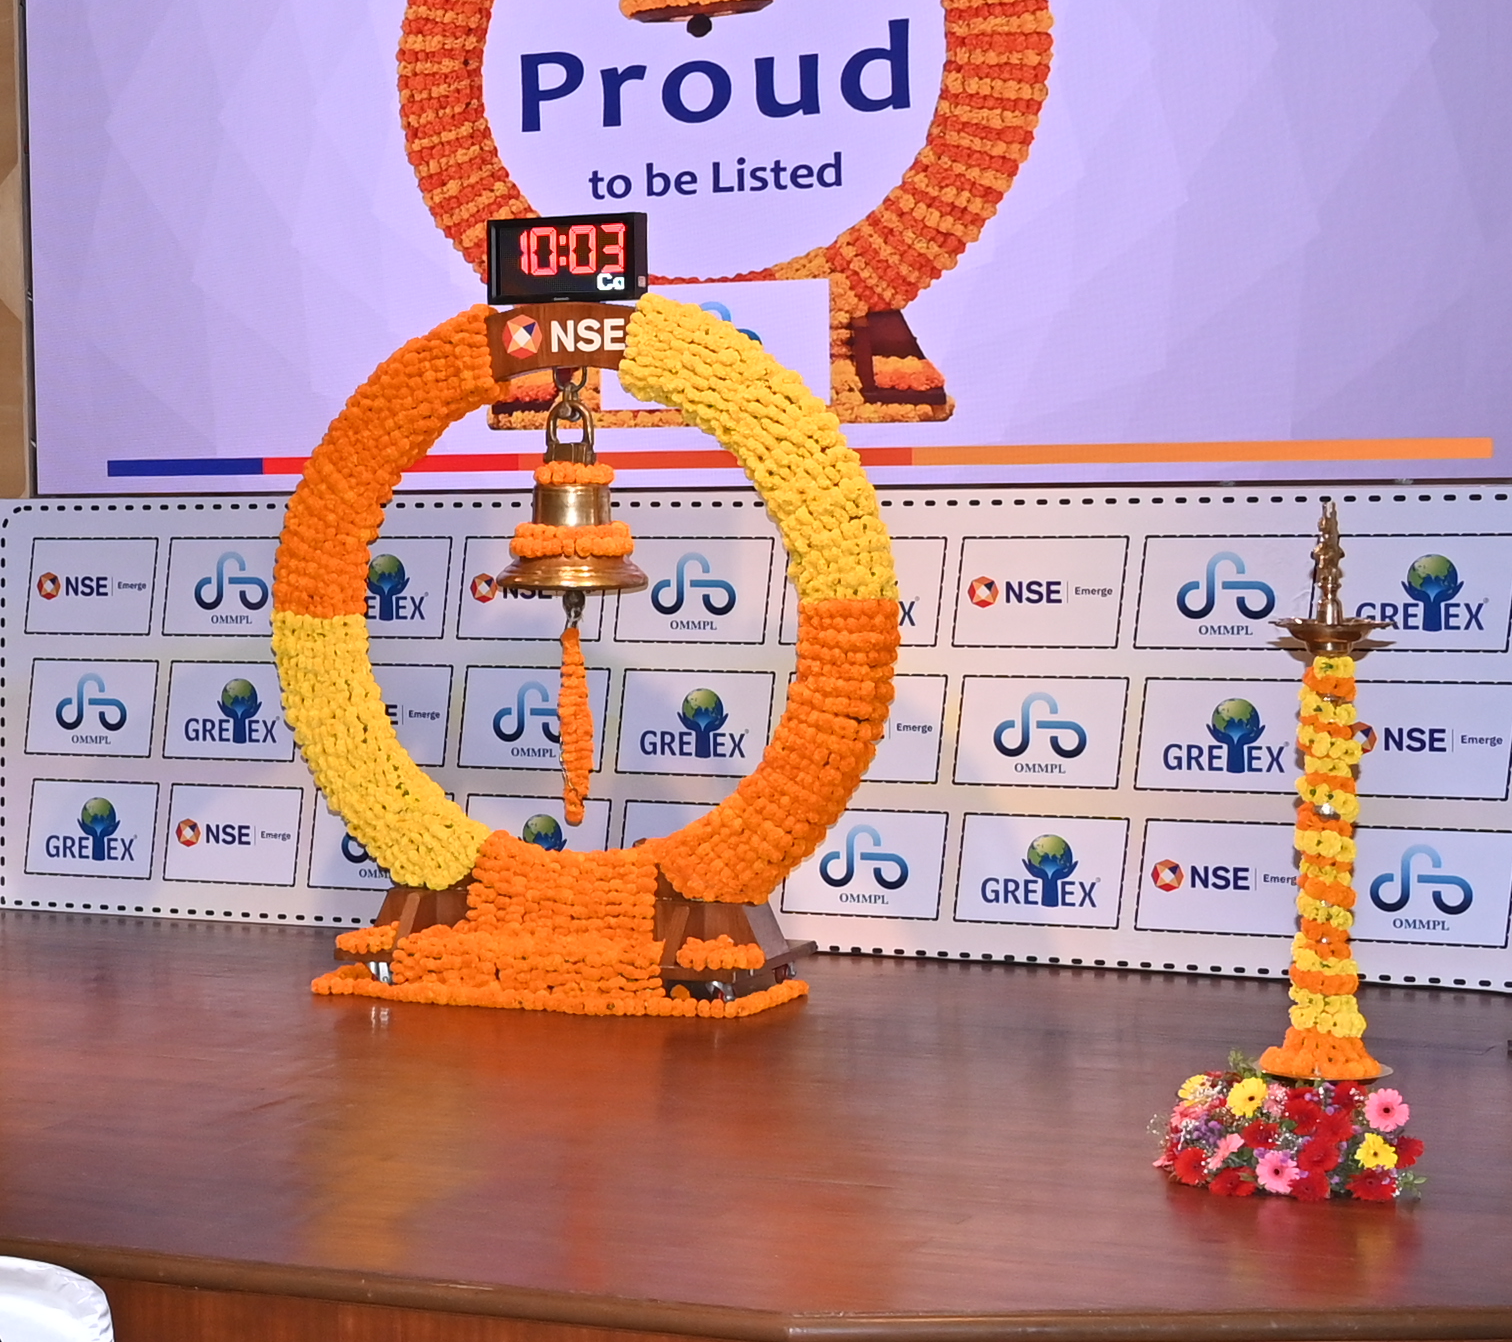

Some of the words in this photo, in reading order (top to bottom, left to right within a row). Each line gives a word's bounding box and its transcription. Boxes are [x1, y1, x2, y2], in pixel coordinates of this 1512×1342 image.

[520, 13, 911, 132] Proud
[588, 169, 633, 200] to
[645, 163, 698, 196] be
[712, 152, 843, 193] Listed
[519, 223, 627, 276] 10:03
[550, 318, 627, 353] NSE
[1384, 727, 1447, 753] NSE
[1460, 734, 1504, 748] Emerge
[1392, 917, 1450, 931] OMMPL
